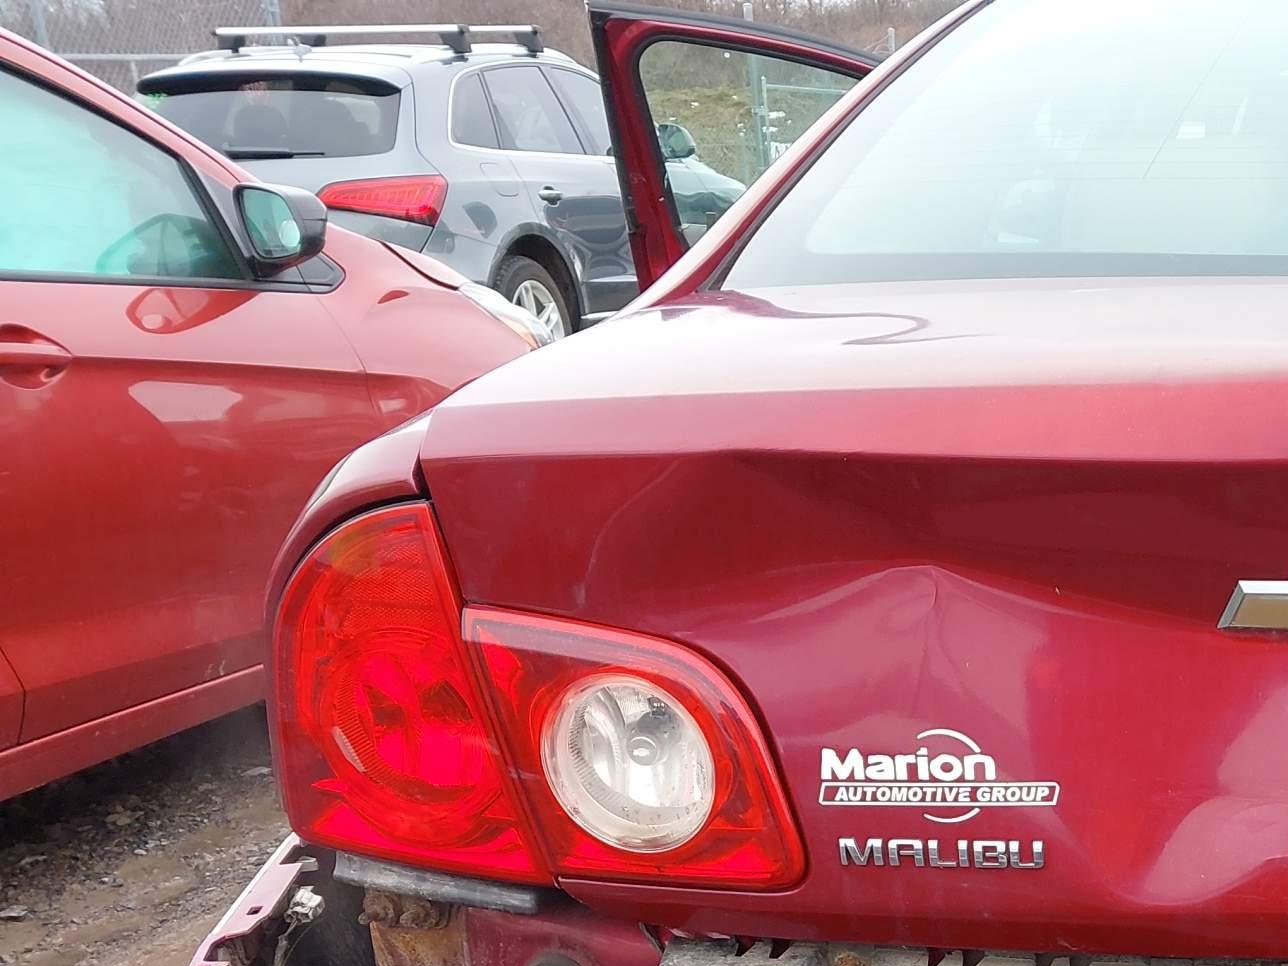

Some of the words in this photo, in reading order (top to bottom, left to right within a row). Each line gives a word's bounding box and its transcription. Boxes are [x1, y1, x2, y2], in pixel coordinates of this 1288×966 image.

[820, 747, 996, 782] Marion
[834, 786, 971, 802] AUTOMOTIVE
[976, 786, 1050, 802] GROUP
[838, 838, 1044, 869] MALIBU
